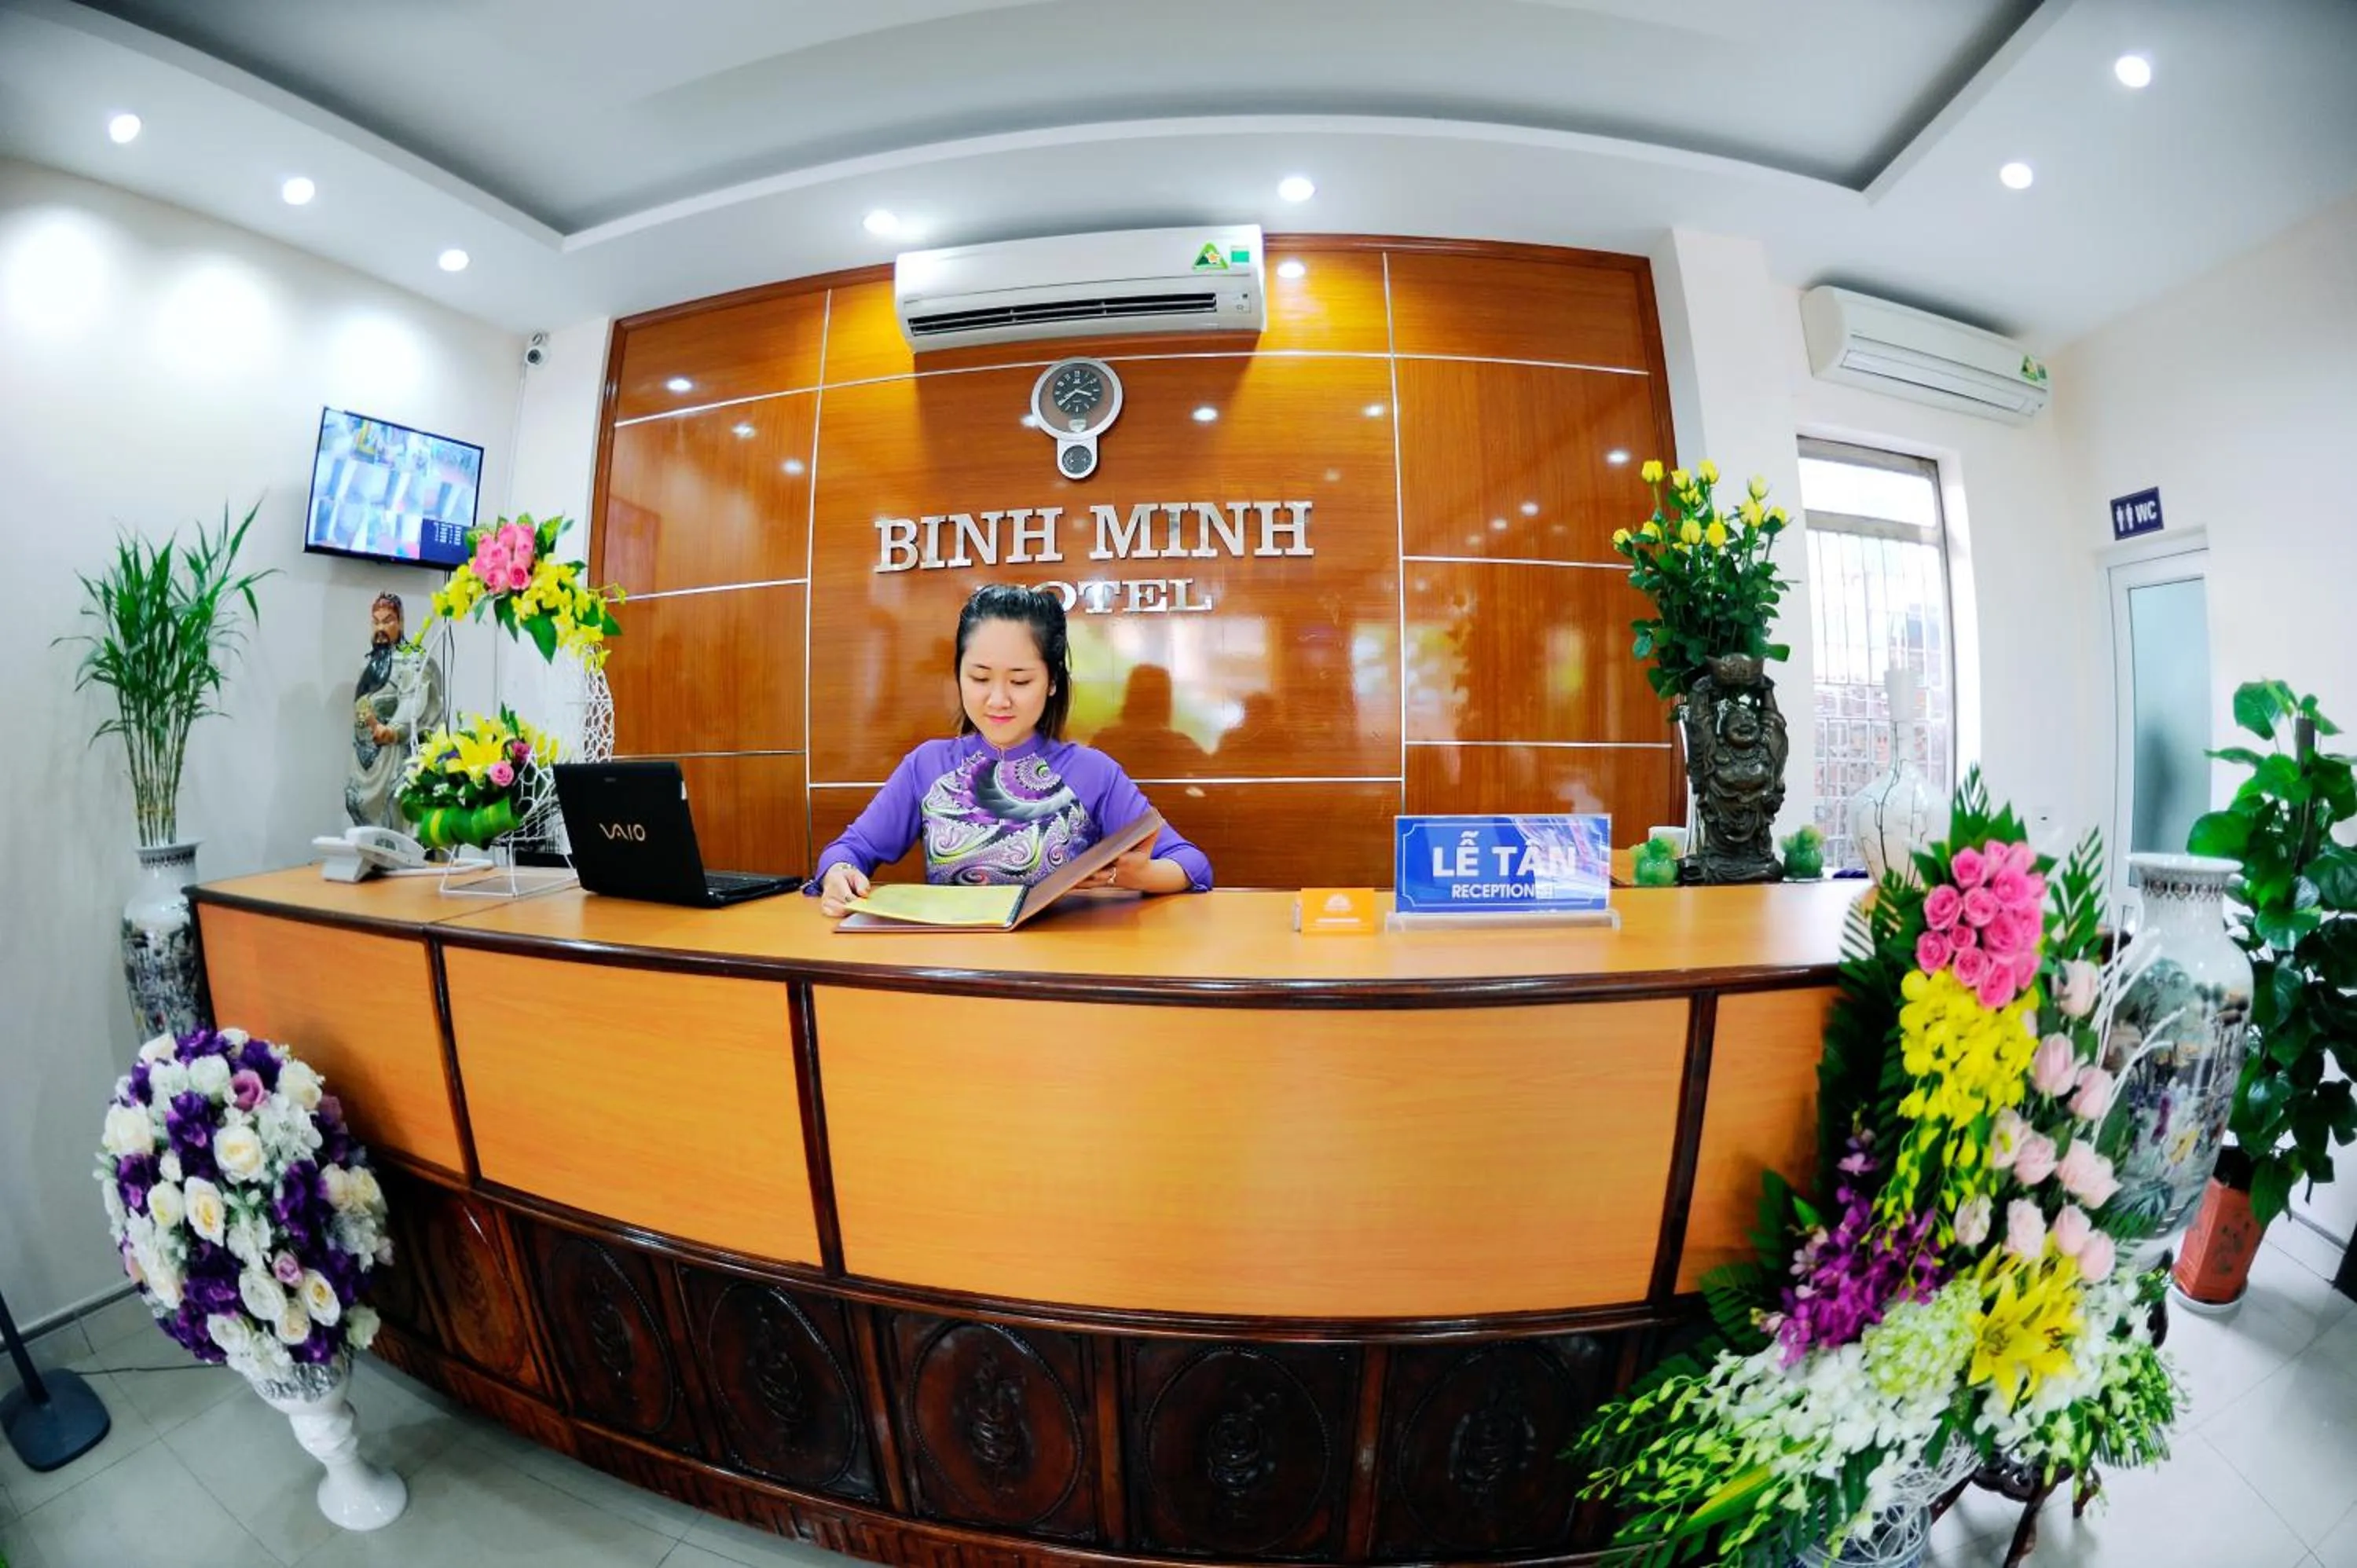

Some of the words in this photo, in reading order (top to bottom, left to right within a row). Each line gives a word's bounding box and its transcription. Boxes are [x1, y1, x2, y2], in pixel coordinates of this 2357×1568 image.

[2135, 500, 2157, 524] WC
[874, 507, 1064, 573] BINH
[1090, 501, 1314, 560] MINH
[977, 577, 1212, 614] OTEL
[599, 822, 647, 841] VAIO
[1432, 830, 1480, 877] LỄ
